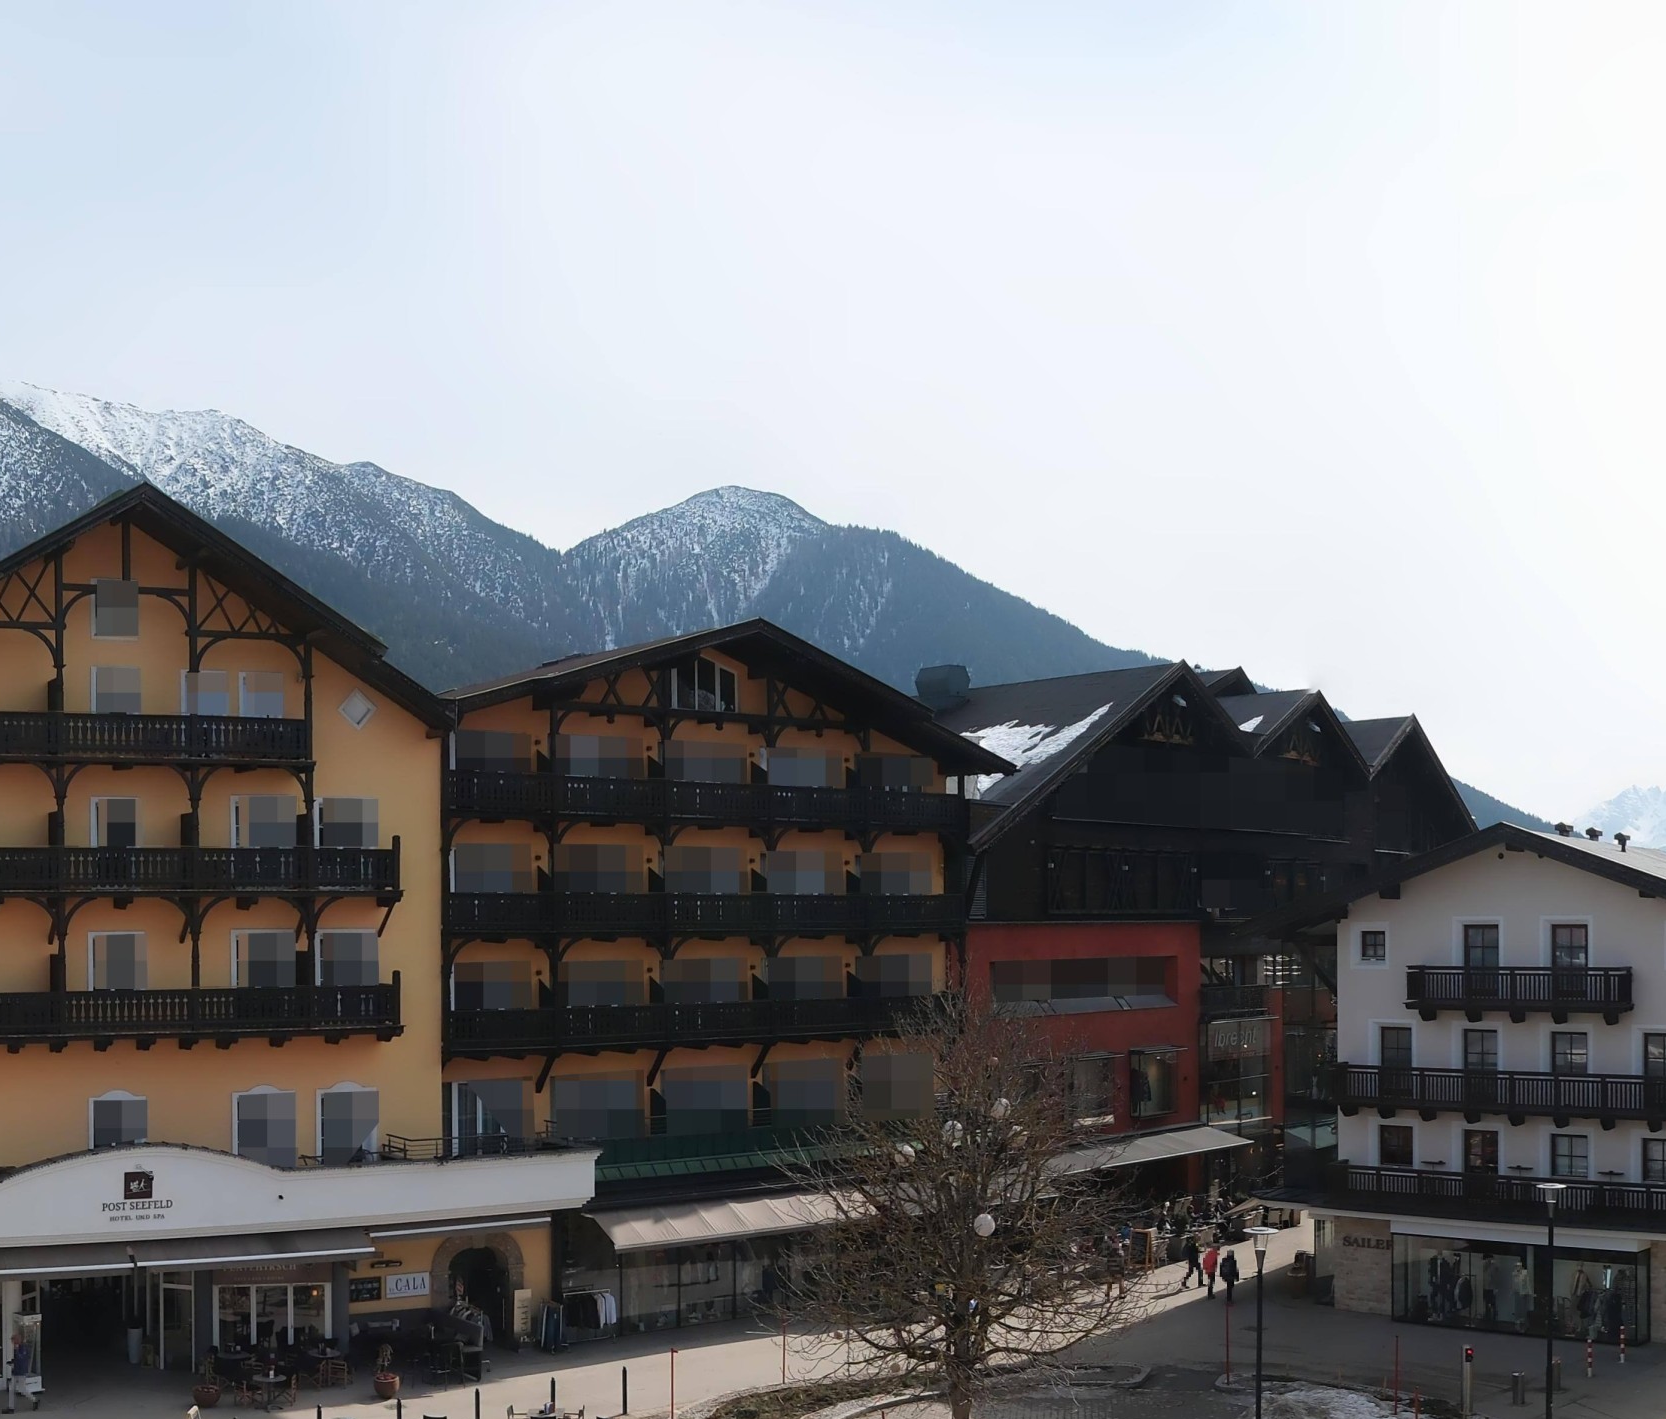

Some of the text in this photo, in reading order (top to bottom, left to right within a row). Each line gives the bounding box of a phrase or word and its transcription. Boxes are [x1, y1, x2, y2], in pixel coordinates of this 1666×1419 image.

[101, 1199, 173, 1212] POST SEEFELD
[109, 1214, 133, 1222] HOTEL
[395, 1276, 426, 1292] CALA
